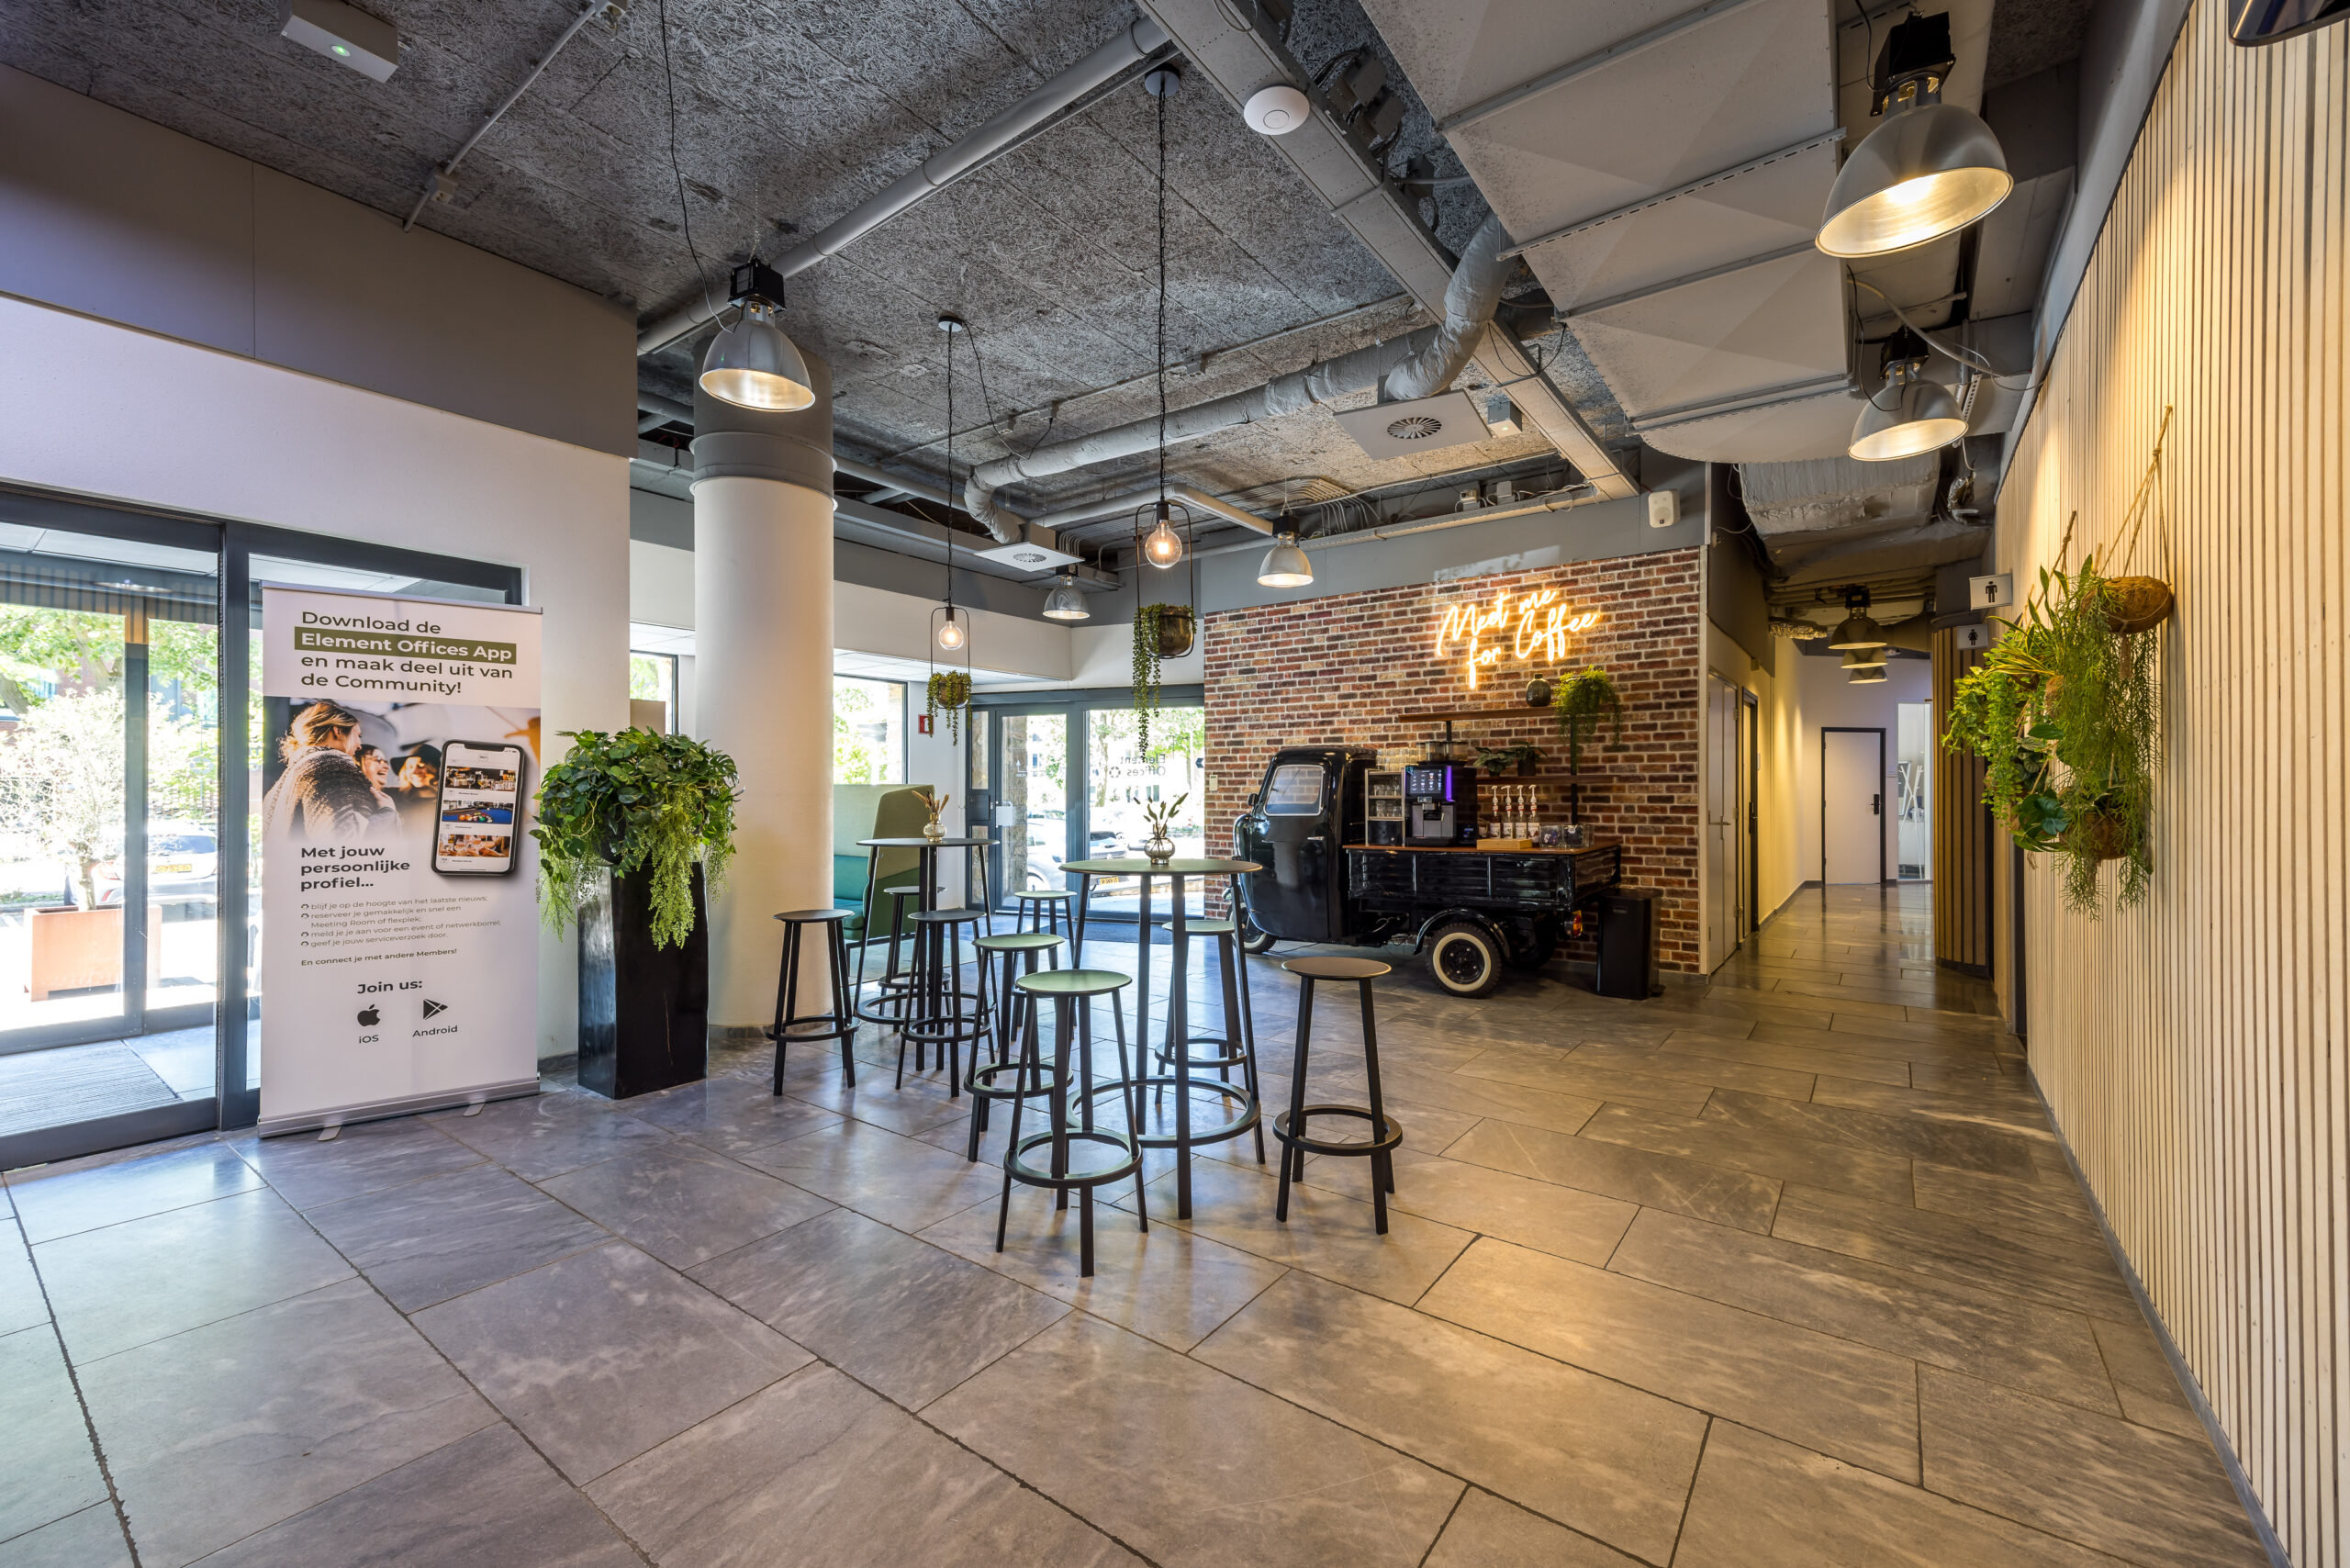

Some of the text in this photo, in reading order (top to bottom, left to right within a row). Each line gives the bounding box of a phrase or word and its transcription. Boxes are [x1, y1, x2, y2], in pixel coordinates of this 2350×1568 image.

[302, 611, 441, 634] Download de
[1436, 590, 1560, 656] Meet me
[302, 632, 512, 661] Element Offices App
[1467, 604, 1600, 689] for Coffee
[301, 657, 512, 679] en maak deel uit van
[301, 673, 462, 696] de Community!
[301, 846, 385, 860] Met jouw
[301, 860, 410, 877] persoonlijke
[301, 877, 373, 892] profiel...
[363, 907, 414, 917] gemakkelijk
[366, 933, 426, 943] serviceverzoek
[416, 948, 457, 957] Members!
[357, 980, 423, 994] Join us:
[412, 1025, 458, 1037] Android
[358, 1034, 379, 1044] iOS
